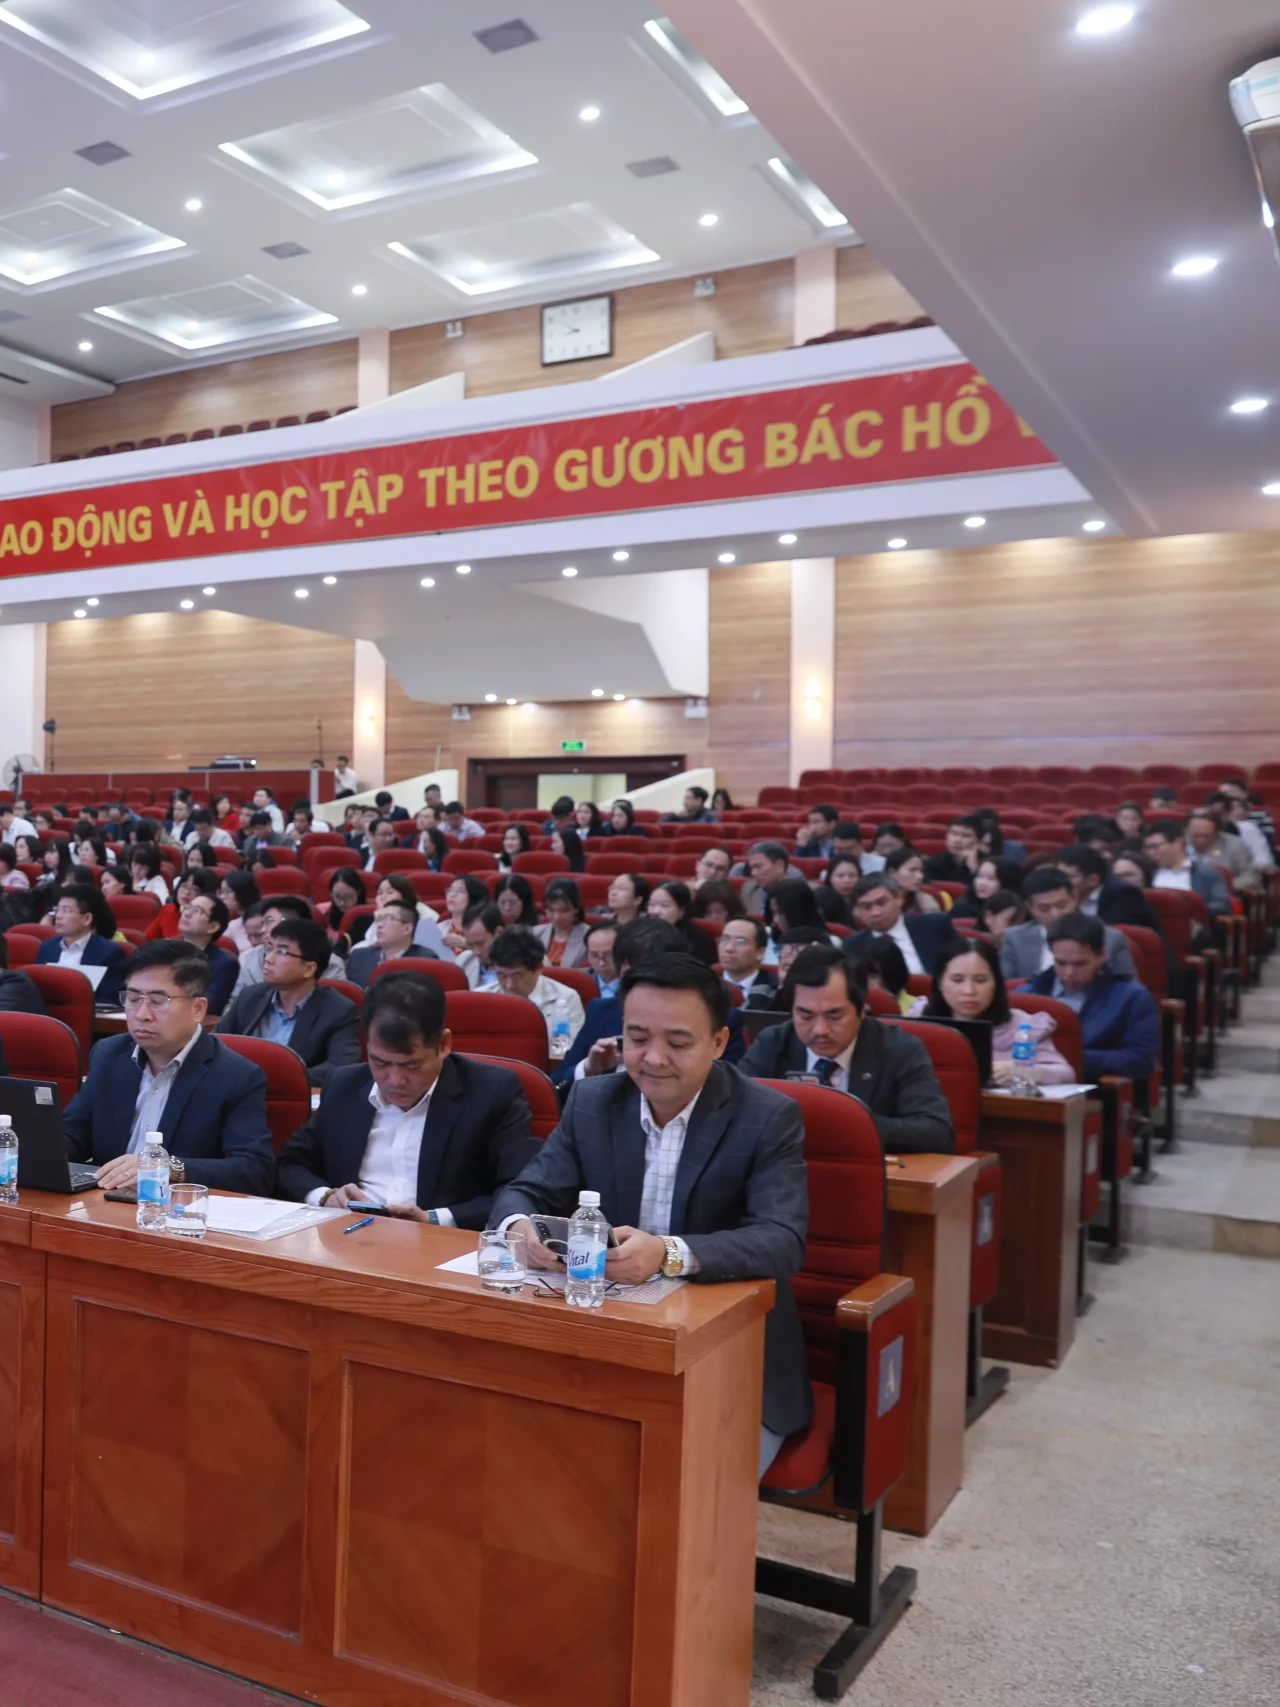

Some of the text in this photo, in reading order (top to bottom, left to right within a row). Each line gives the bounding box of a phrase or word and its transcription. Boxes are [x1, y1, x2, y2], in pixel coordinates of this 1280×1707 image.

[52, 504, 152, 556] ĐỘNG
[163, 490, 215, 537] VÀ
[226, 486, 307, 538] HỌC
[320, 468, 403, 526] TẬP
[419, 456, 539, 507] THEO
[555, 429, 744, 491] GƯƠNG
[766, 404, 881, 466] BÁC
[568, 1248, 590, 1267] Vital
